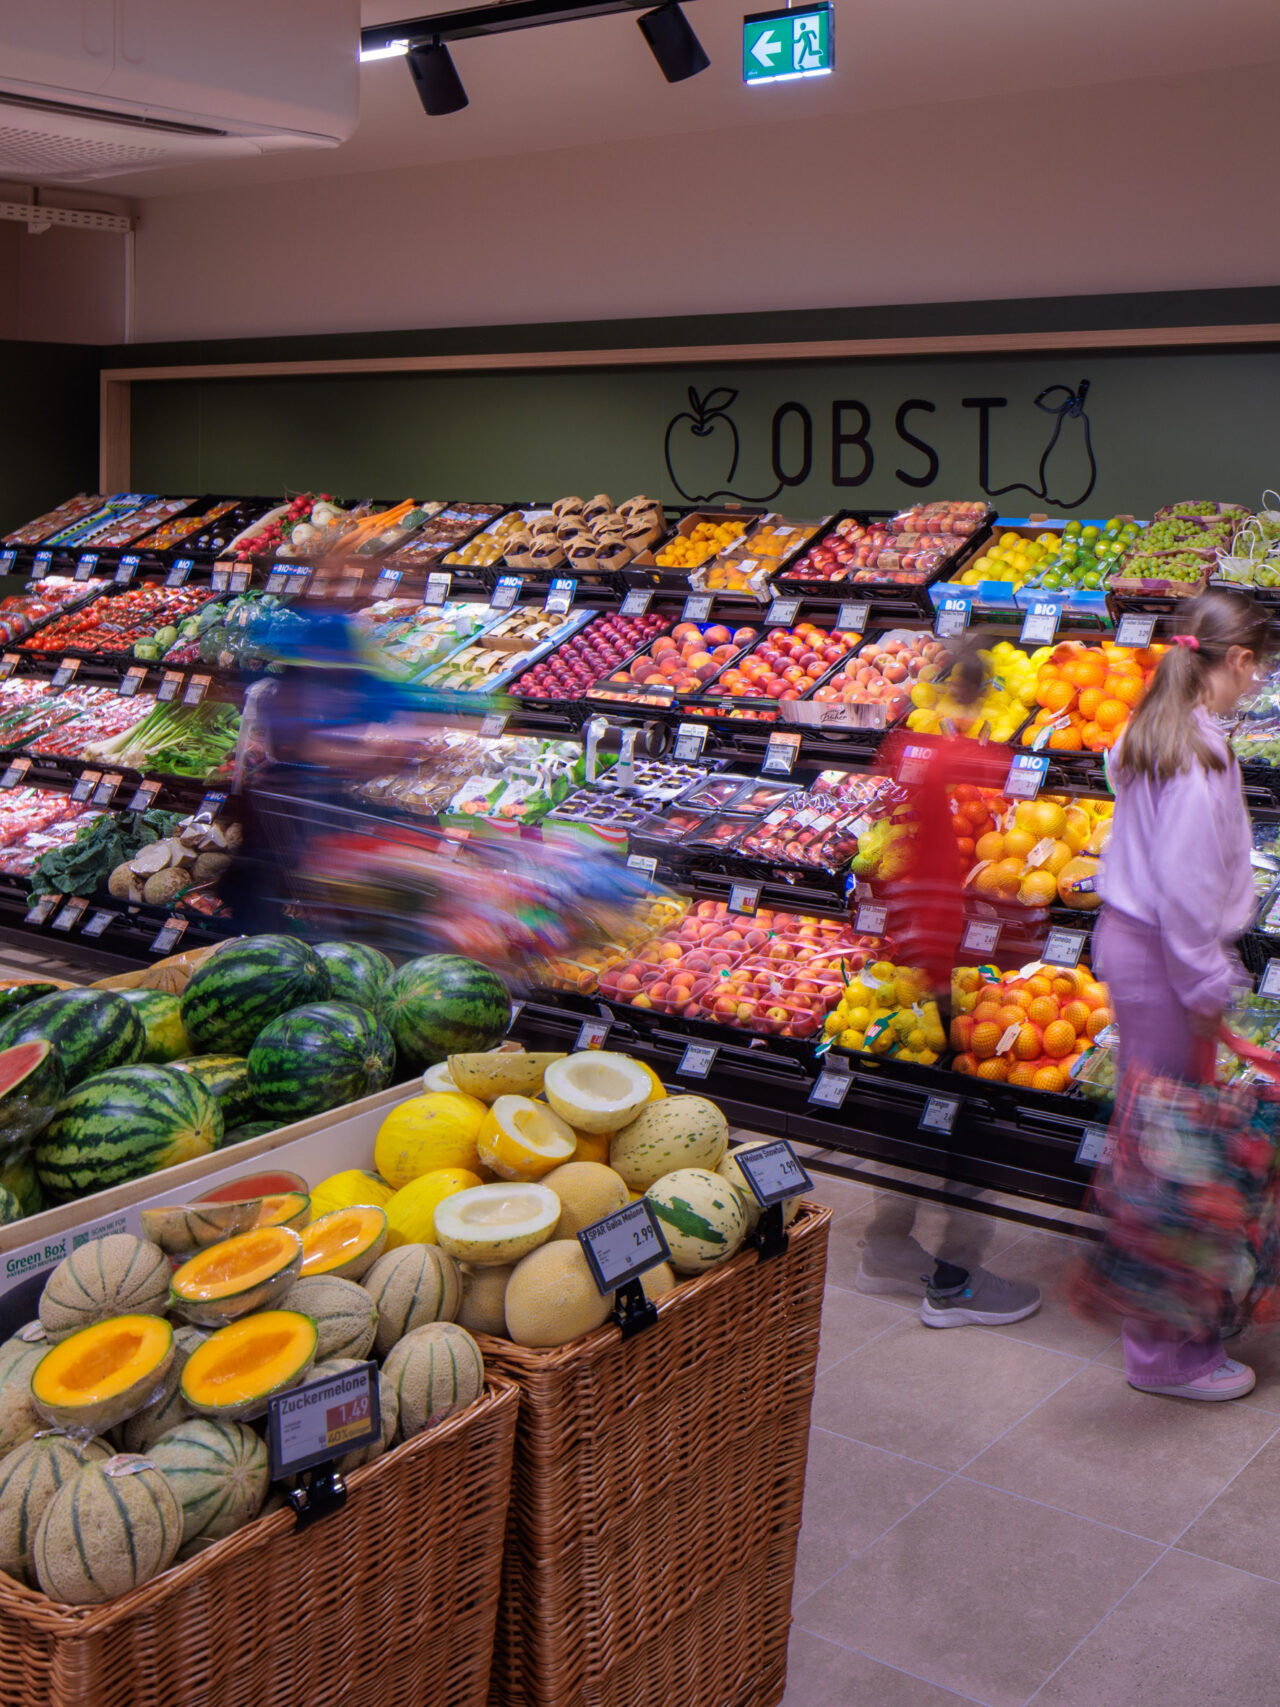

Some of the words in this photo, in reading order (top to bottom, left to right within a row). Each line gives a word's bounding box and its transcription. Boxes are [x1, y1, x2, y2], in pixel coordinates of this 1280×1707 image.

[771, 397, 1007, 488] OBST
[126, 556, 136, 564] BIO
[177, 560, 190, 569] BIO
[296, 566, 308, 575] BIO
[384, 569, 399, 579] BIO
[504, 576, 518, 587] BIO
[556, 579, 572, 590] BIO
[945, 600, 964, 611] BIO
[1034, 603, 1057, 615] BIO
[910, 747, 932, 760] BIO
[1020, 756, 1042, 769] BIO
[210, 792, 223, 800] BIO
[745, 1153, 762, 1165] Melone
[762, 1145, 785, 1160] Snowball
[780, 1160, 798, 1176] 2.99
[588, 1226, 607, 1242] SPAR
[607, 1218, 622, 1235] Galia
[623, 1206, 644, 1226] Melone
[633, 1225, 655, 1247] 2.99
[6, 1251, 41, 1273] Green
[44, 1241, 67, 1259] Box
[6, 1262, 37, 1278] PATENTED
[281, 1375, 367, 1416] Zuckermelone
[339, 1398, 368, 1422] 1.49
[328, 1428, 348, 1443] 40%
